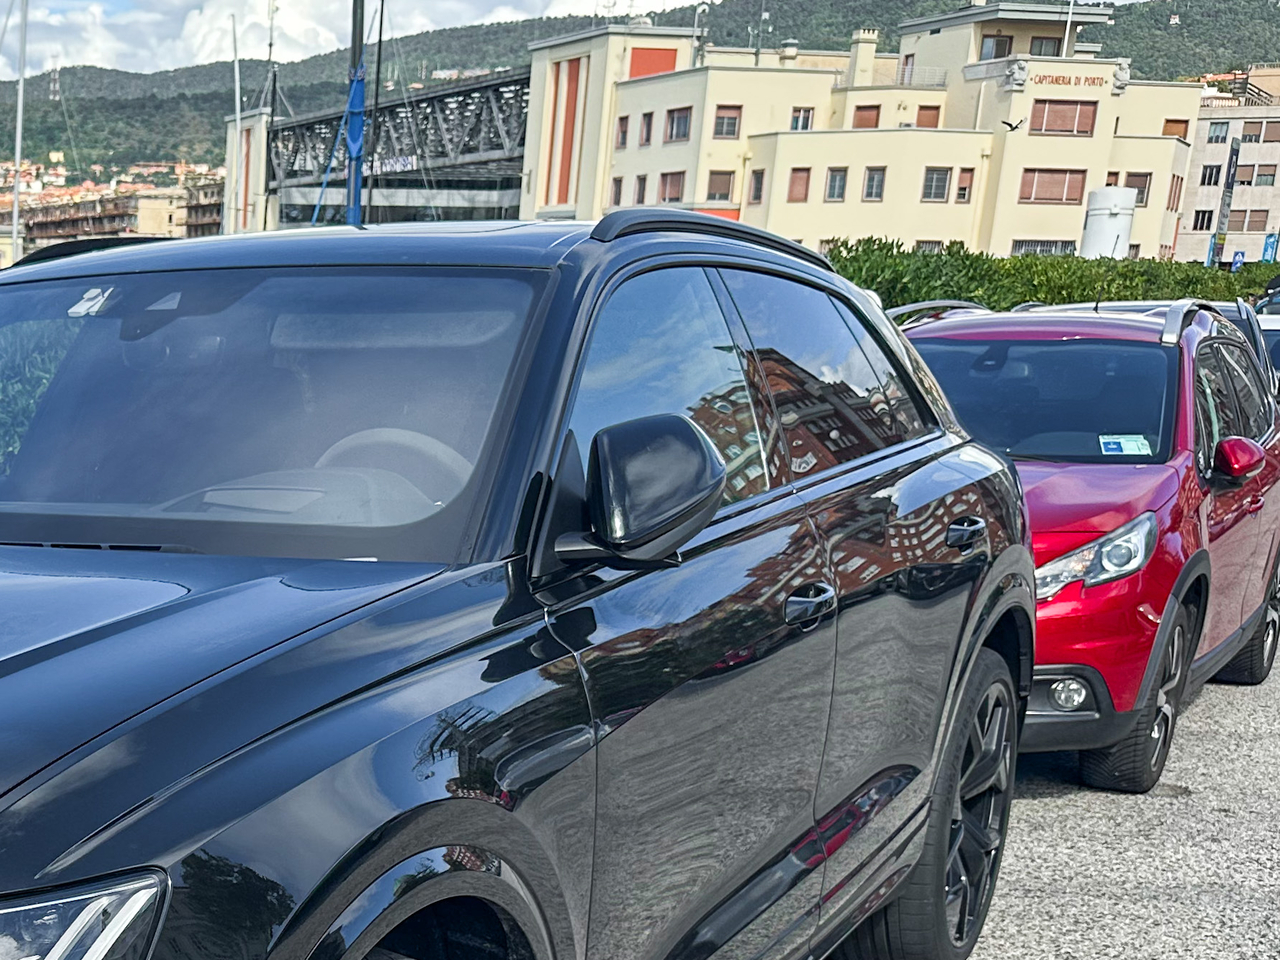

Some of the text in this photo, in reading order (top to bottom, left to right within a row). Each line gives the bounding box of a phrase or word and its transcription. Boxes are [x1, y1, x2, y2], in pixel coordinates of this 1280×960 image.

[1034, 74, 1104, 87] CAPITANERIA DI PORTO
